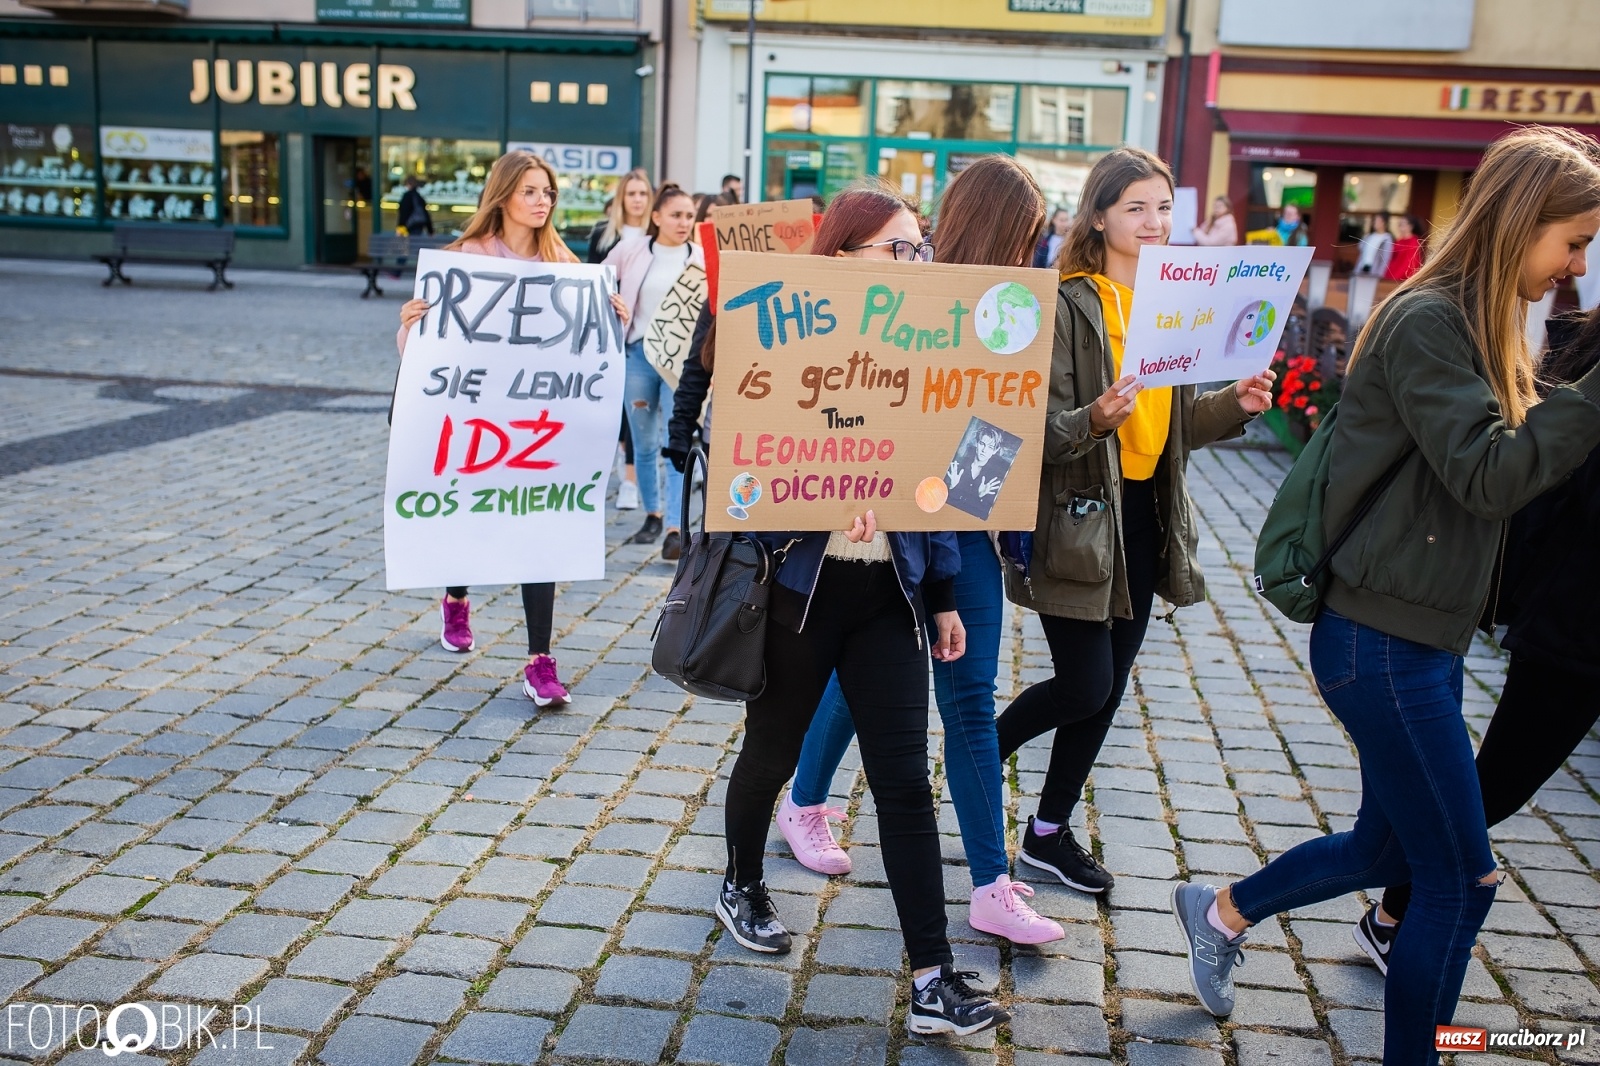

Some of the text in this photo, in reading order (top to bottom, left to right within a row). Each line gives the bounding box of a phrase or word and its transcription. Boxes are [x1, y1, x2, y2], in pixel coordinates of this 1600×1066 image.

[190, 59, 417, 110] JUBILER
[1481, 88, 1596, 113] RESTA
[515, 145, 618, 170] ASIO
[717, 224, 804, 252] MAKE LOVE
[1160, 260, 1291, 286] Kochaj planetę,
[1156, 307, 1215, 331] tak jak
[1139, 348, 1200, 376] kobietę!
[423, 362, 608, 403] SIĘ LENIĆ
[737, 350, 1042, 414] is getting HOTTER
[821, 408, 865, 429] Than
[732, 432, 895, 467] LEONARDO
[395, 471, 602, 518] COŚ ZMIENIĆ
